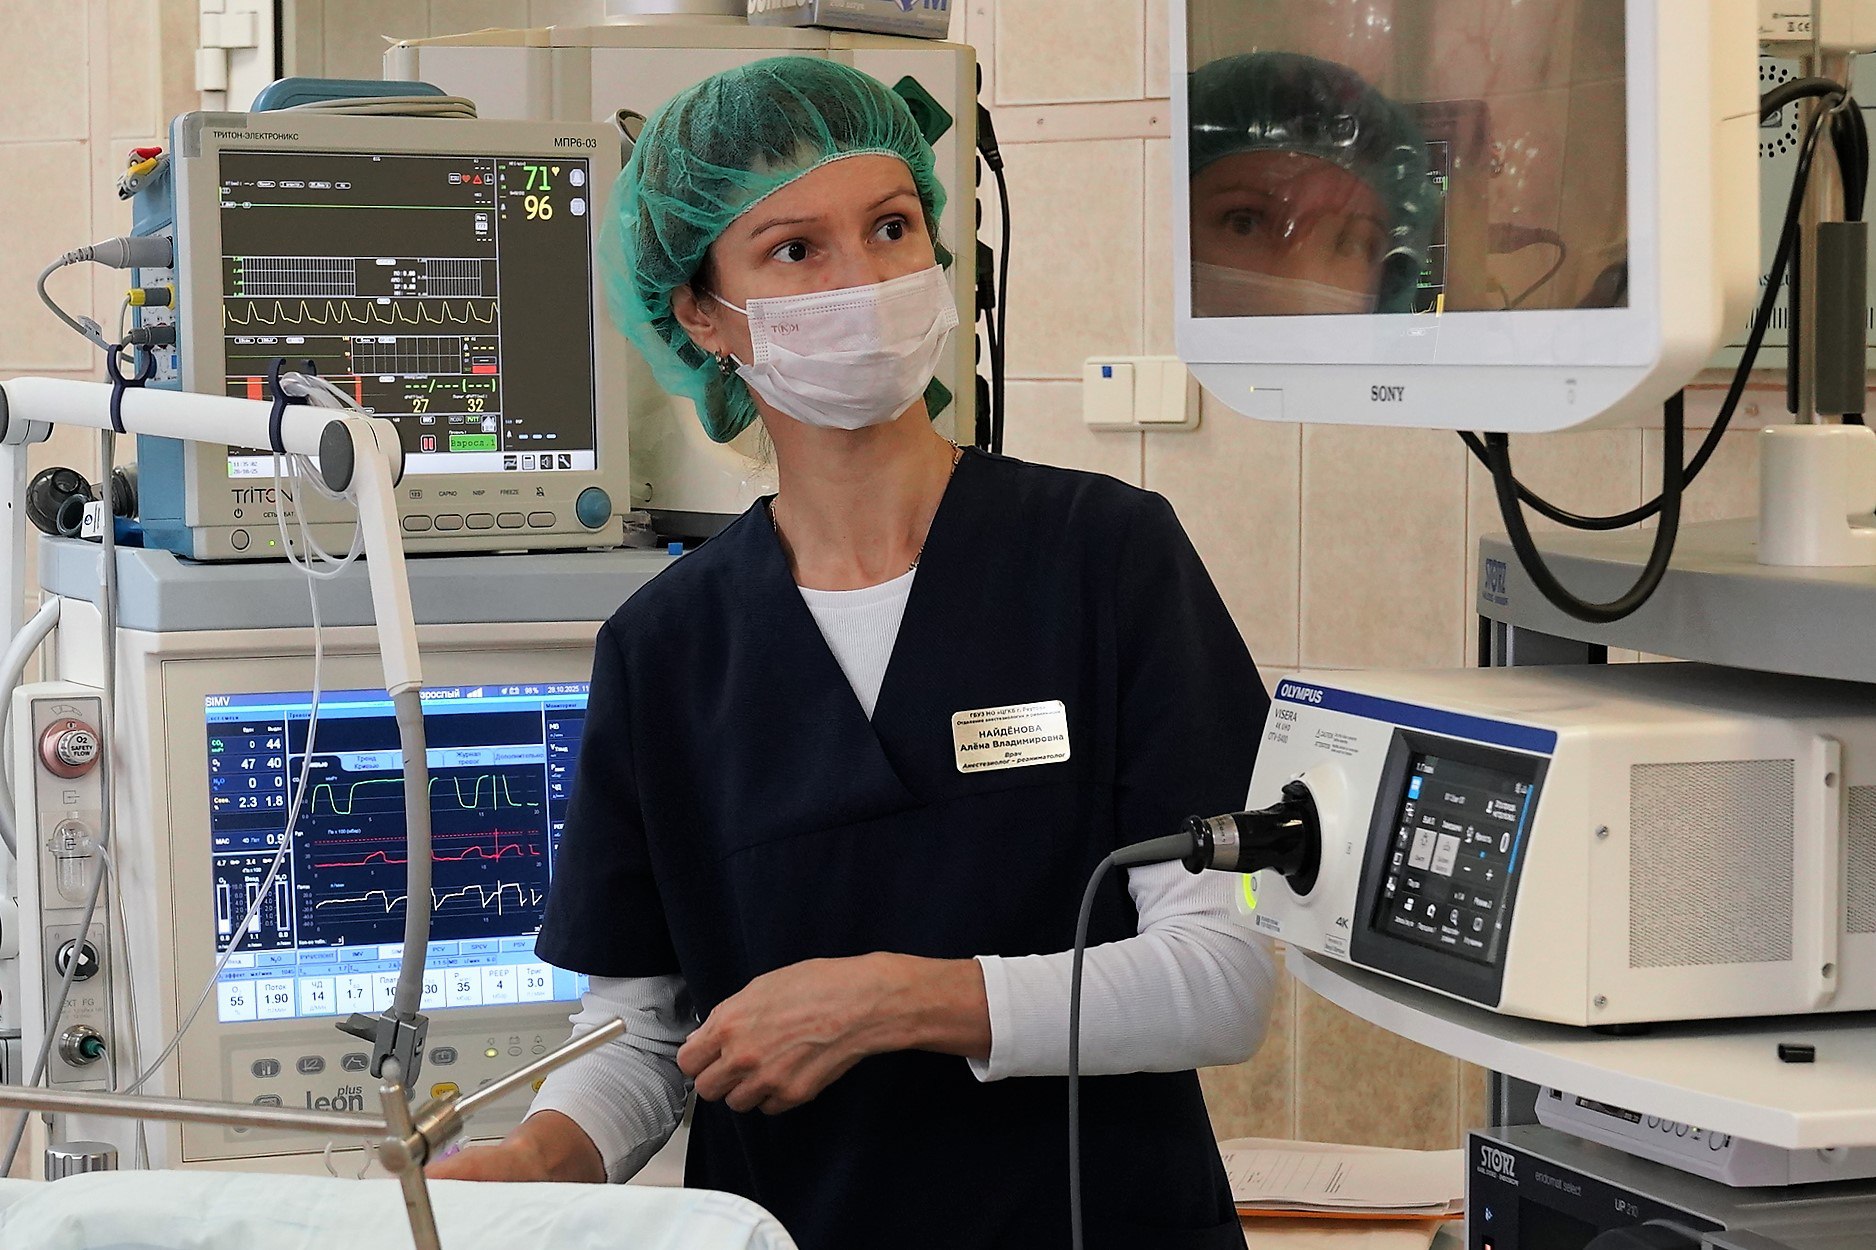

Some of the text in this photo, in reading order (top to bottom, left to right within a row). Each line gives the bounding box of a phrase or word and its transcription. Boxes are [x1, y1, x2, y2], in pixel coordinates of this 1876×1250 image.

[213, 131, 299, 144] ТРИТОН-ЭЛЕКТРОНИКС
[553, 137, 597, 151] МПР6-03
[522, 165, 551, 191] 71
[524, 195, 553, 221] 96
[1371, 385, 1404, 402] SONY
[412, 398, 430, 413] 27
[467, 398, 485, 413] 32
[547, 686, 580, 694] 28.10.2025
[1280, 683, 1324, 704] OLYMPUS
[206, 697, 230, 707] SIMV
[1274, 707, 1297, 723] VISERA
[979, 725, 1042, 738] НАЙДЁНОВА
[70, 744, 93, 752] SAFETY
[249, 740, 255, 749] 0
[266, 738, 282, 750] 44
[960, 734, 1064, 752] Алёна Владимировна
[962, 759, 1010, 770] Анестезиолог
[1017, 753, 1065, 764] реаниматолог
[1004, 751, 1023, 759] Врач
[241, 758, 256, 770] 47
[267, 757, 282, 769] 40
[249, 777, 257, 789] 0
[275, 776, 283, 788] 0
[239, 797, 258, 808] 2.3
[266, 795, 284, 807] 1.8
[1335, 916, 1349, 929] 4K
[264, 983, 287, 992] Поток
[457, 983, 472, 992] 35
[496, 981, 503, 989] 4
[527, 978, 544, 988] 3.0
[264, 993, 289, 1005] 1.90
[311, 991, 325, 1002] 14
[347, 988, 364, 1000] 1.7
[82, 998, 95, 1007] FG
[230, 996, 245, 1007] 55
[337, 1085, 363, 1098] plus
[306, 1090, 364, 1112] leon
[1481, 1145, 1516, 1178] STORZ
[1535, 1171, 1563, 1189] endomat
[1563, 1181, 1583, 1197] select
[1614, 1197, 1627, 1213] UP
